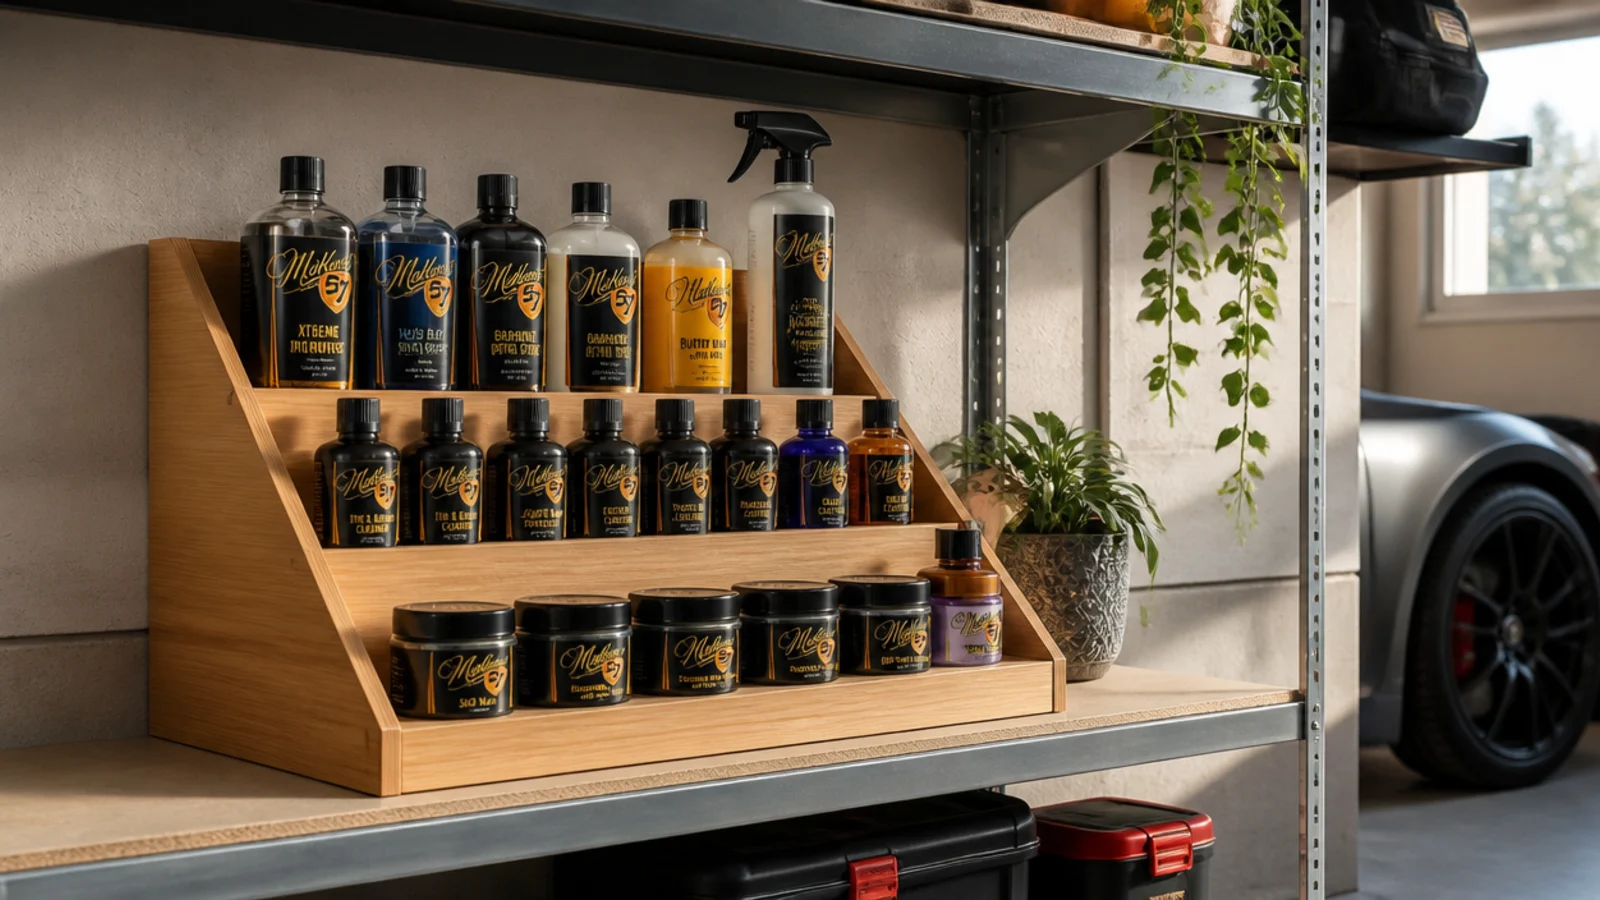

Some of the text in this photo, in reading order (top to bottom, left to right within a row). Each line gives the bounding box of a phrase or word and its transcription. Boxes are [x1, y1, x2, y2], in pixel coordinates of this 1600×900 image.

[325, 274, 350, 304] 57
[429, 280, 451, 307] 57
[522, 284, 541, 311] 57
